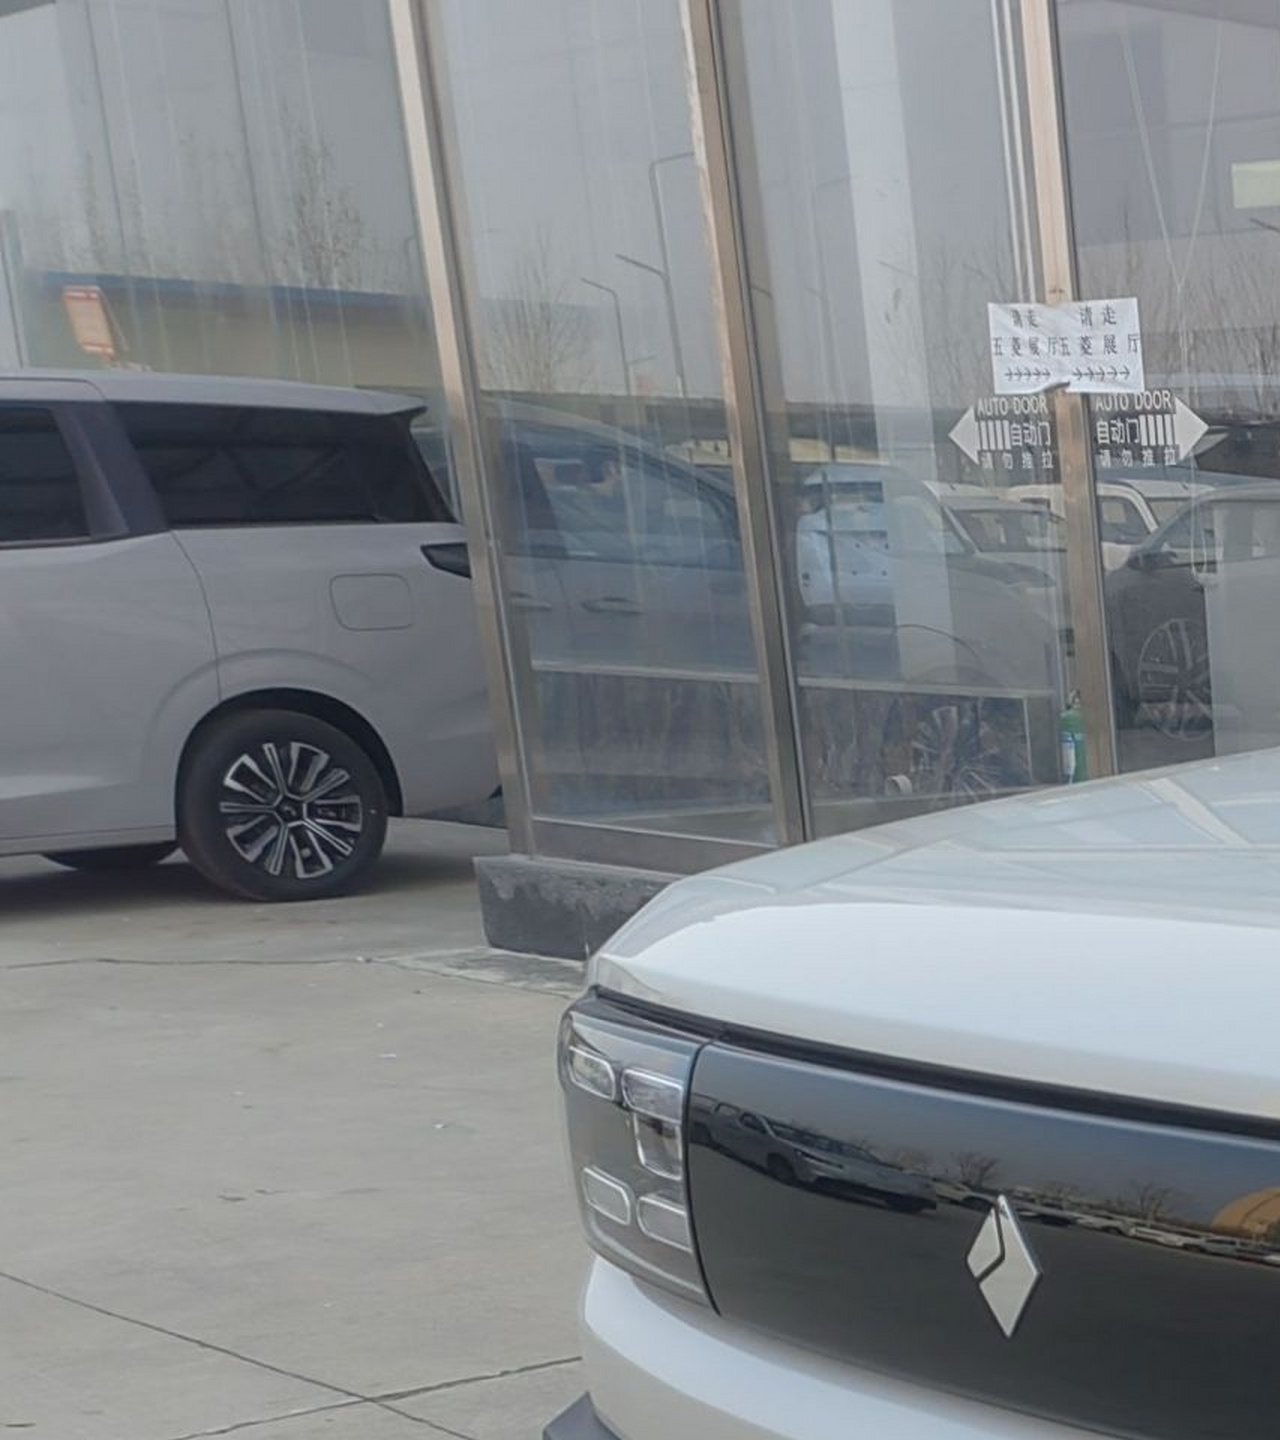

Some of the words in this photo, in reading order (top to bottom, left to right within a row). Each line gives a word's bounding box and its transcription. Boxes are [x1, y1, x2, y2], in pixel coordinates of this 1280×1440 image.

[1010, 309, 1040, 328] 请走
[1079, 304, 1117, 327] 请走
[1058, 333, 1140, 357] 五菱展厅
[977, 397, 1008, 416] AUTO
[1013, 396, 1049, 415] DOOR
[1095, 394, 1129, 412] AUTO
[1134, 390, 1173, 410] DOOR
[1011, 421, 1052, 447] 自动门
[1096, 417, 1140, 444] 自动门
[980, 449, 1054, 470] 请勿推拉
[1098, 446, 1177, 468] 请勿推拉
